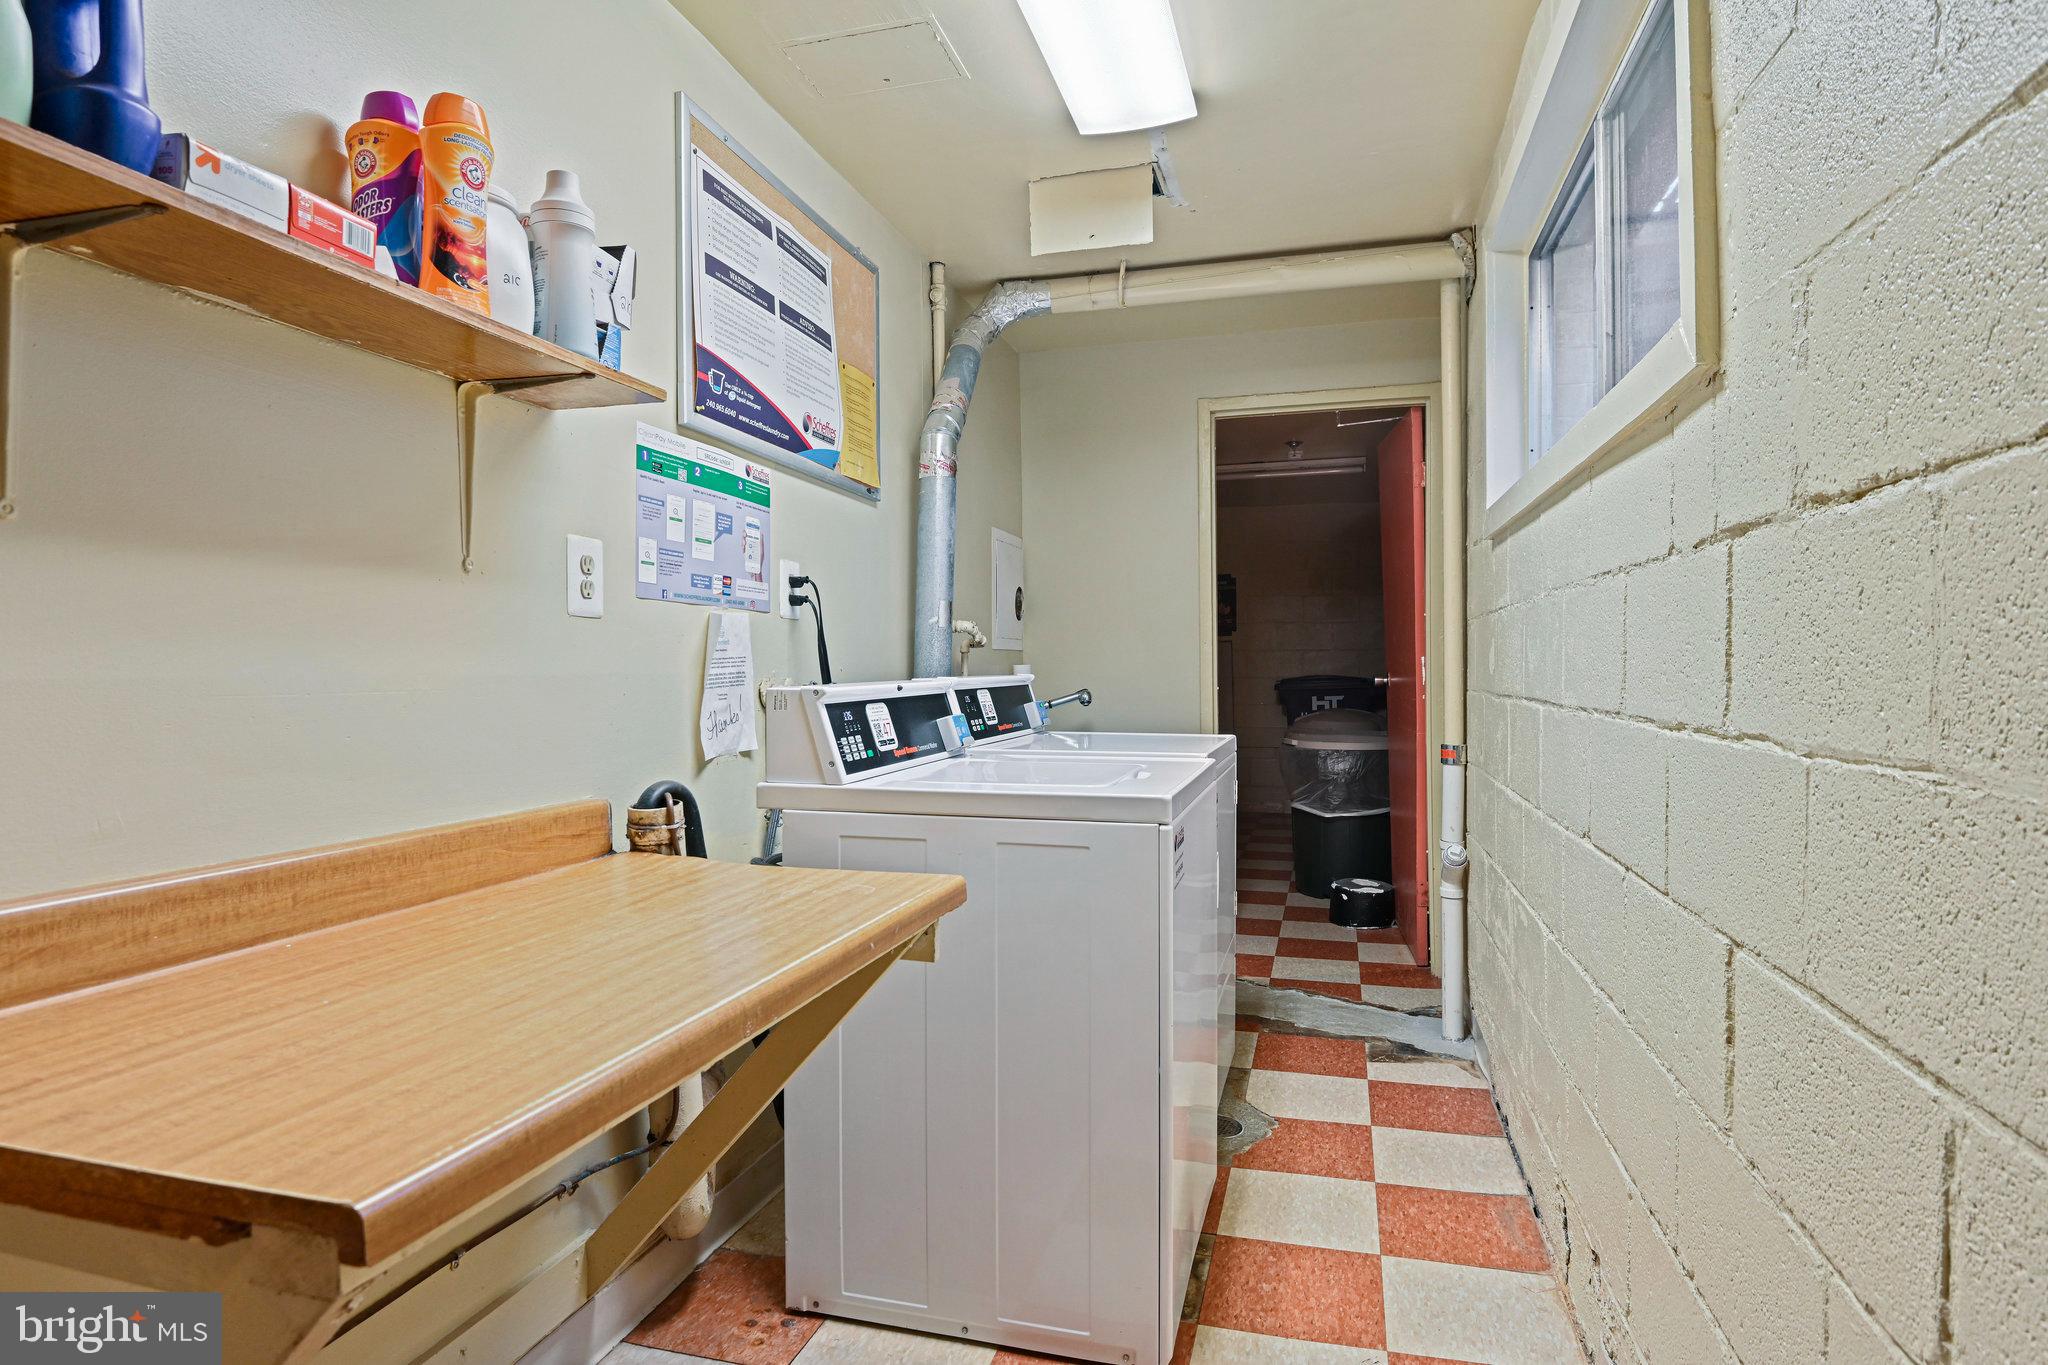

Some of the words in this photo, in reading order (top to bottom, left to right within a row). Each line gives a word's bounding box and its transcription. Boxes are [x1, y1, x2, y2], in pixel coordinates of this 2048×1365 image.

[224, 163, 246, 176] dryer
[353, 188, 378, 212] ODOR
[453, 186, 486, 208] clean
[729, 270, 756, 295] WARNING:
[706, 399, 736, 418] 240.965.6040
[739, 415, 789, 440] www.scheffreslaundry.com
[813, 417, 837, 439] Scheffres
[695, 467, 700, 476] 2
[738, 481, 743, 490] 3
[1312, 695, 1344, 710] HT
